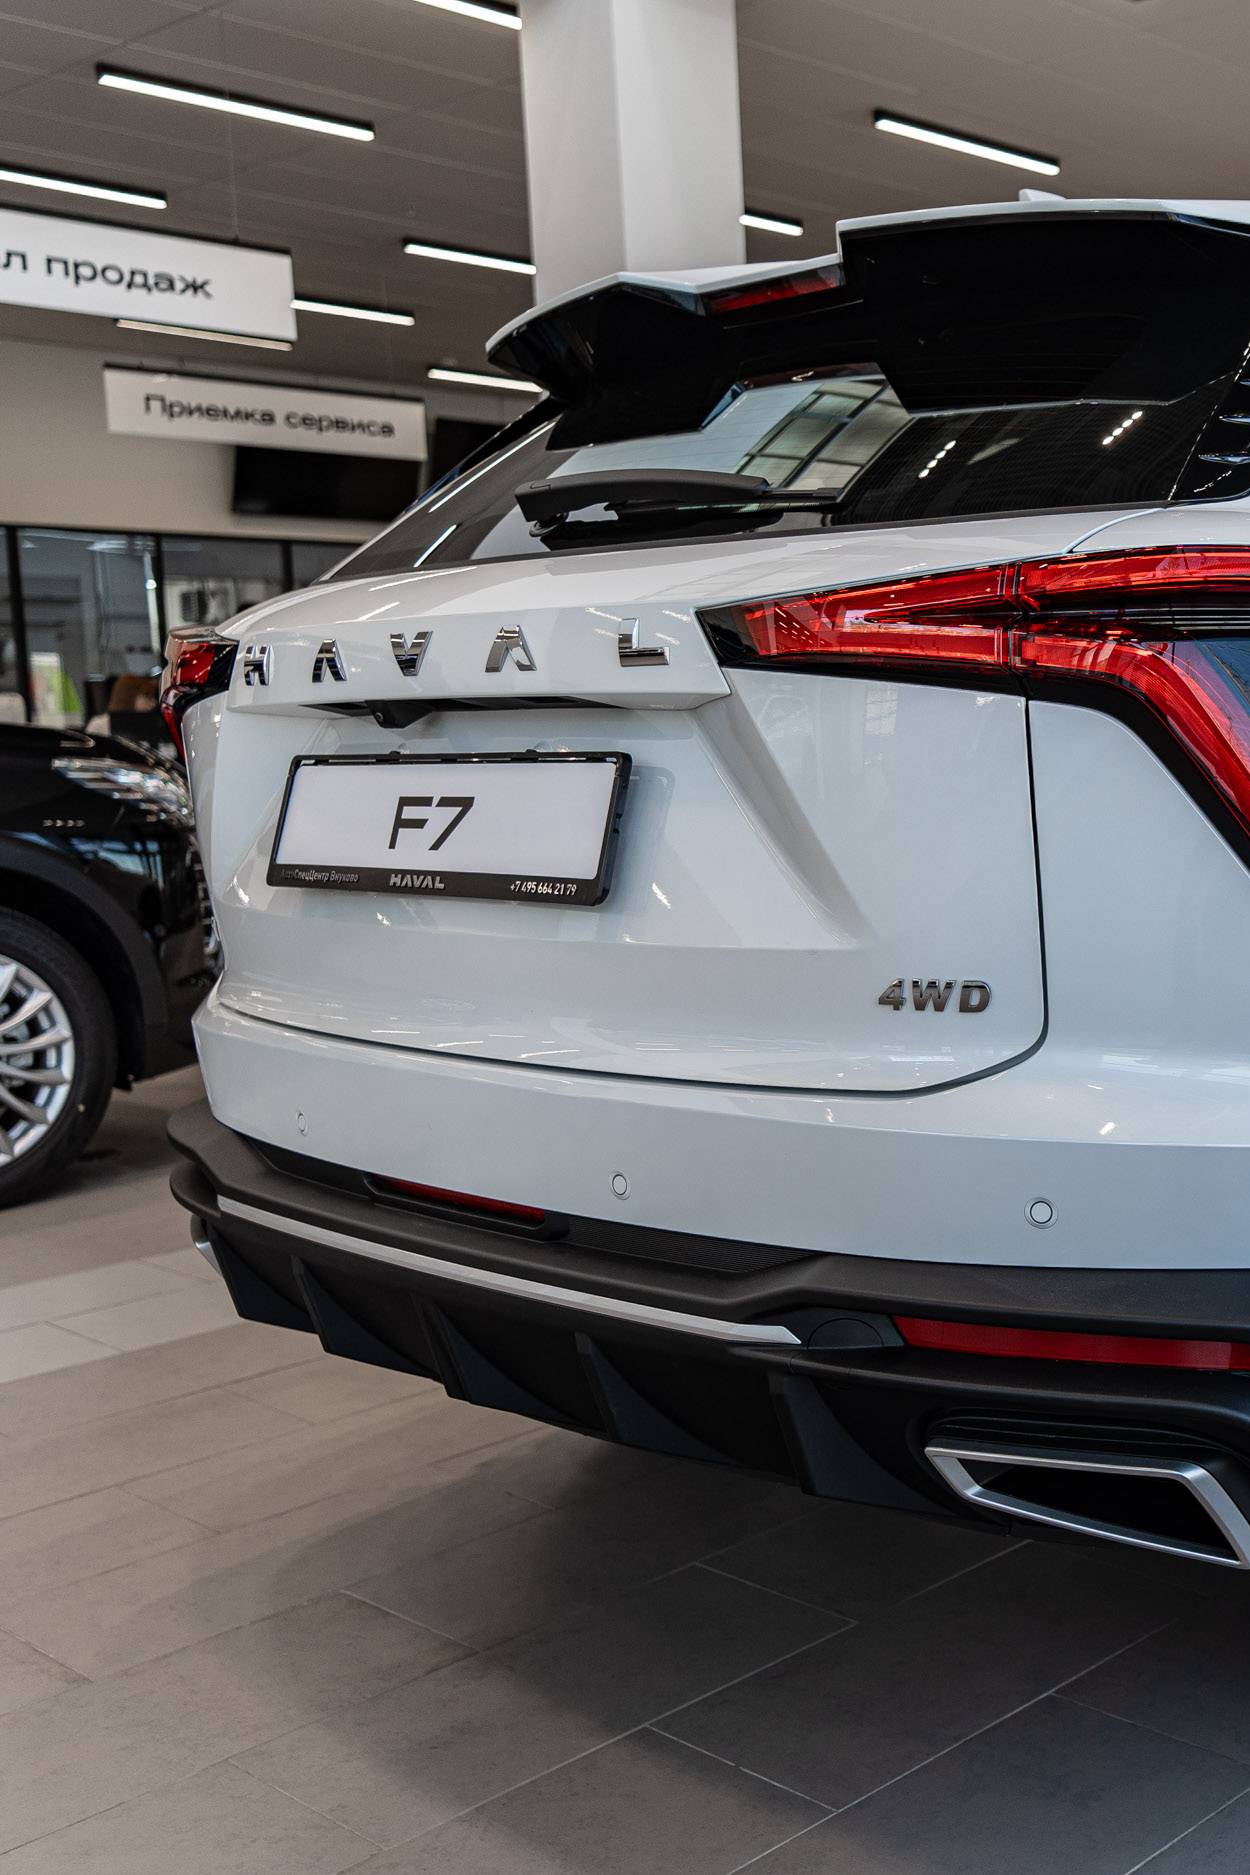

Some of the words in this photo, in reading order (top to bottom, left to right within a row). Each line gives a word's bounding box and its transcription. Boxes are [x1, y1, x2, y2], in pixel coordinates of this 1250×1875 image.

[0, 249, 28, 272] л
[46, 255, 213, 299] продаж
[144, 393, 276, 426] Приемка
[284, 411, 395, 437] сервиса
[243, 617, 671, 687] HAVAL
[388, 796, 475, 851] F7
[389, 873, 445, 889] HAVAL
[510, 880, 521, 892] +7
[521, 881, 538, 893] 495
[537, 882, 553, 894] 664
[553, 883, 565, 895] 21
[566, 884, 577, 896] 79
[878, 978, 992, 1013] 4WD
